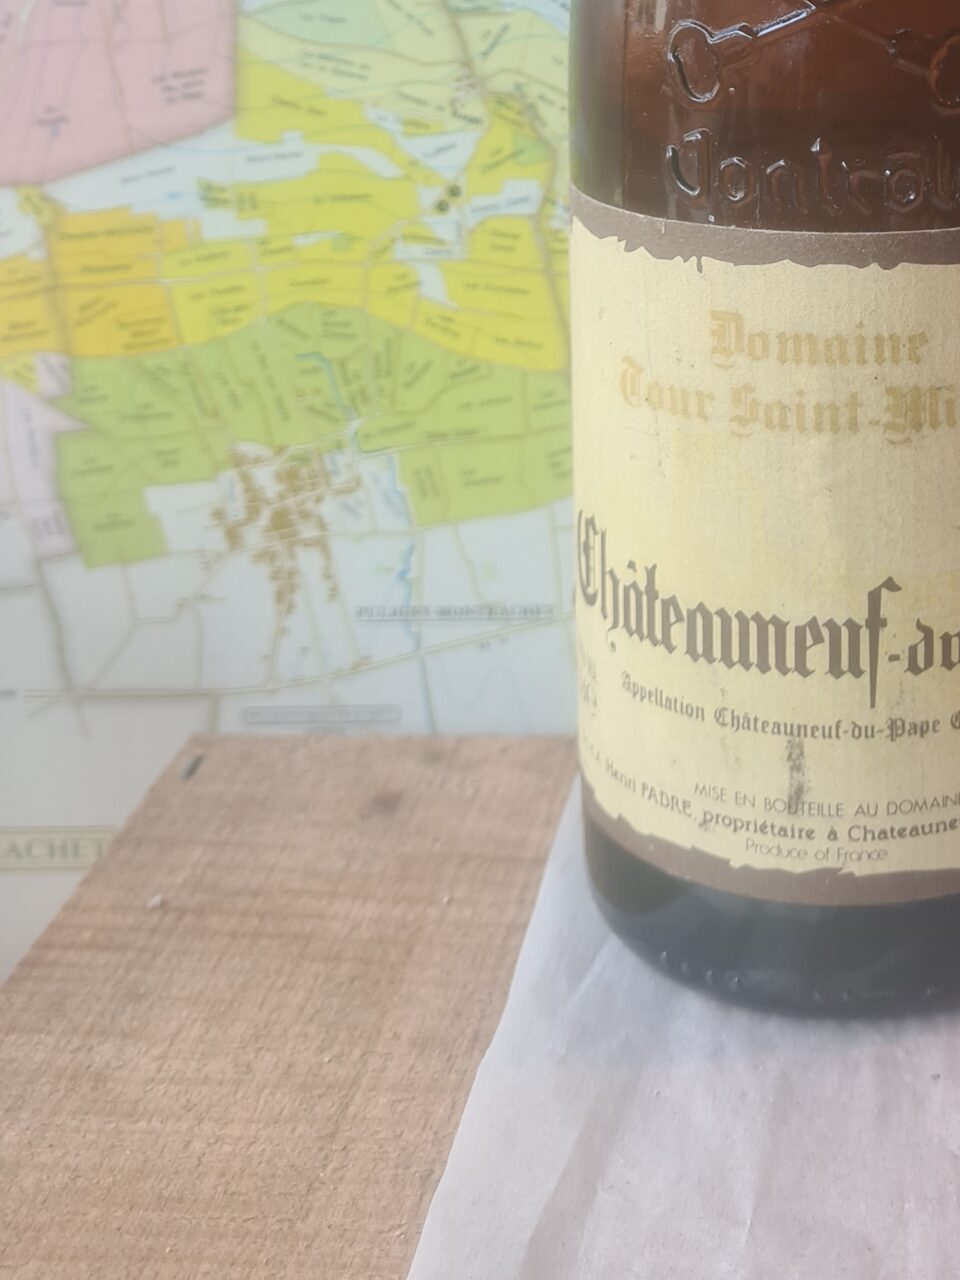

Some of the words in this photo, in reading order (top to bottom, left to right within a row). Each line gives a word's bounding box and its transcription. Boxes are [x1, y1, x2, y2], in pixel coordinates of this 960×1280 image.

[709, 308, 929, 370] Domaine
[620, 670, 706, 722] Appellation
[713, 705, 941, 743] Châteauneuf-du-Pape
[693, 782, 728, 804] MISE
[734, 789, 756, 808] EN
[763, 797, 844, 818] BOUTEILLE
[854, 800, 879, 818] AU
[702, 807, 816, 841] propriétaire
[826, 825, 840, 842] à
[746, 836, 808, 861] Produce
[814, 847, 834, 861] of
[836, 845, 889, 862] France
